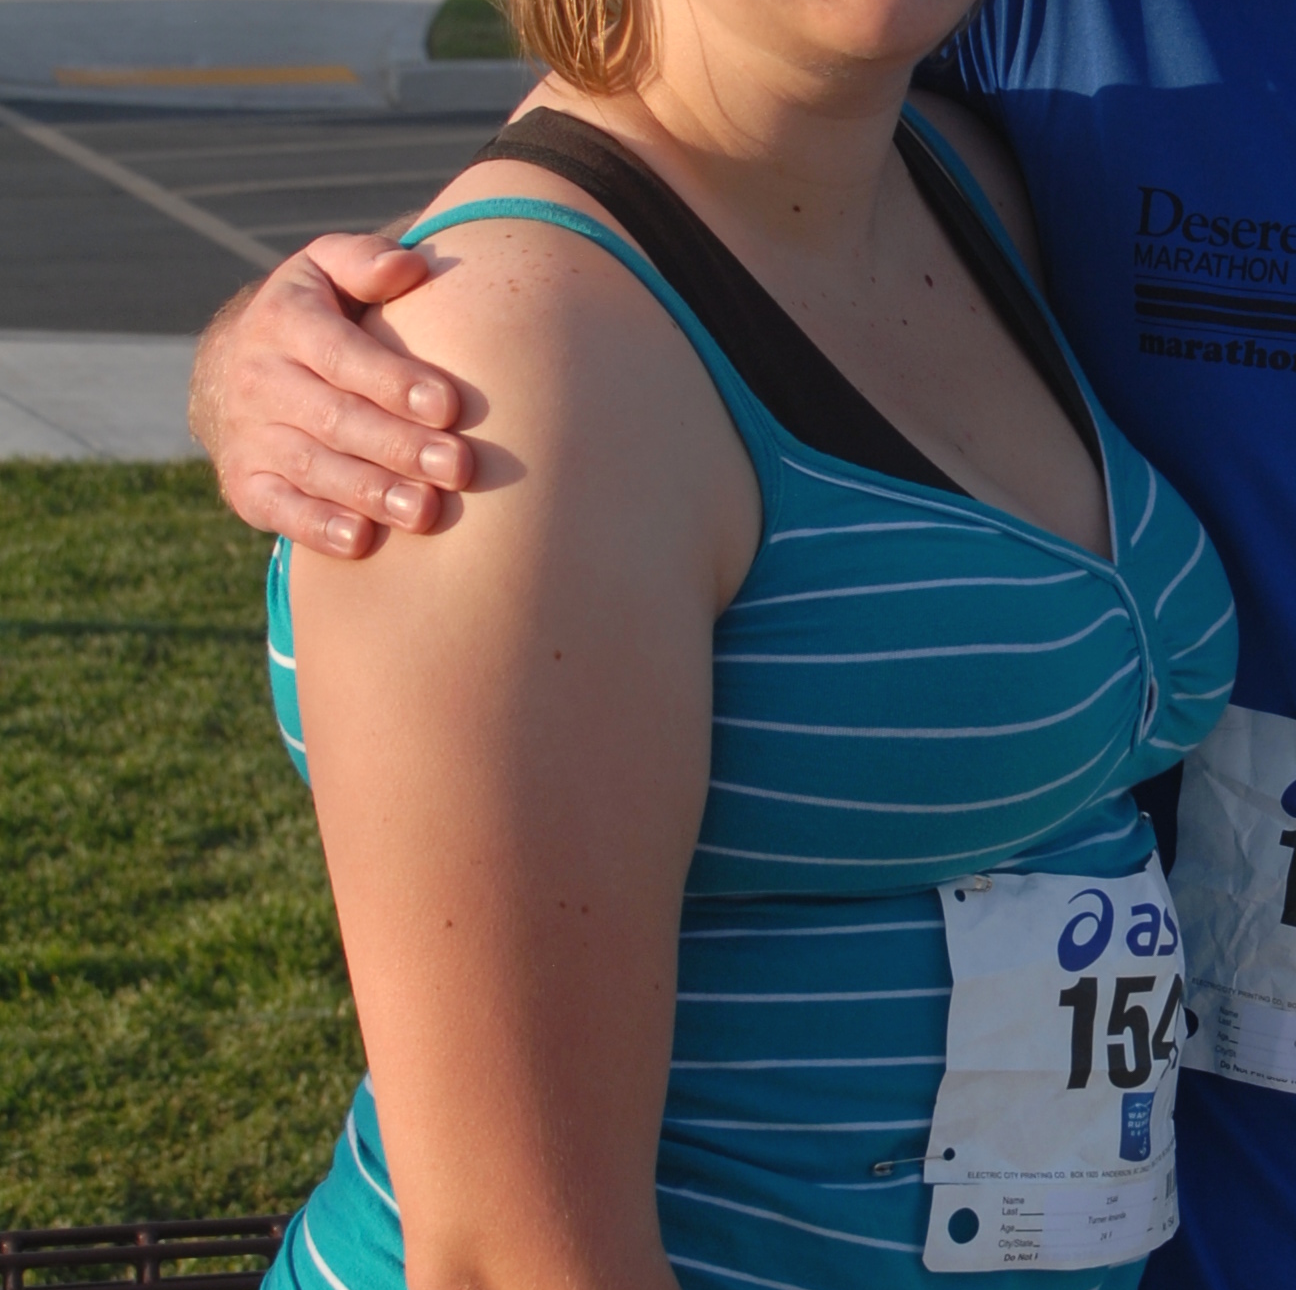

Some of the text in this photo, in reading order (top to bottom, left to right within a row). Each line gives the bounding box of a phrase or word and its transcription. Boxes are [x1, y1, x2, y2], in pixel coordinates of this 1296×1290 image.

[1133, 242, 1289, 285] MARATHON
[967, 1171, 1003, 1179] ELECTRIC
[1020, 1171, 1053, 1180] PRINTING
[1002, 1196, 1025, 1205] Name
[1002, 1207, 1019, 1216] Last
[1000, 1223, 1015, 1234] Age
[998, 1239, 1034, 1250] City/State
[1004, 1253, 1033, 1262] Do Not
